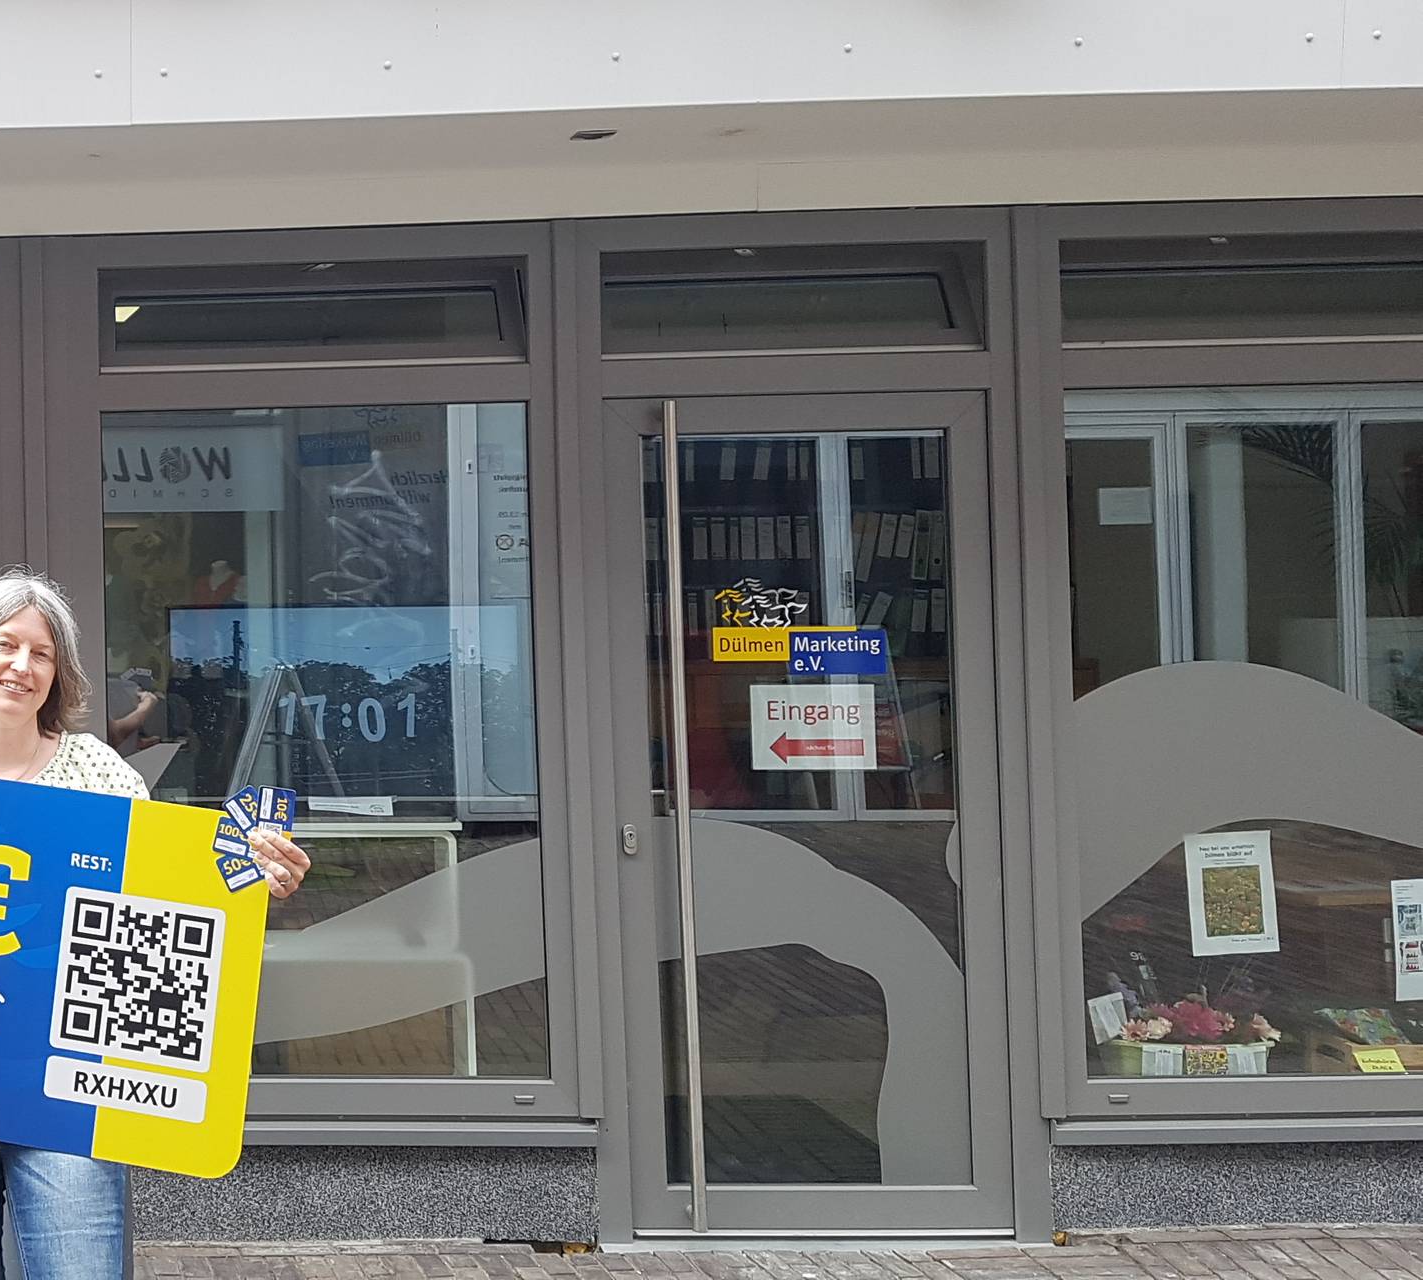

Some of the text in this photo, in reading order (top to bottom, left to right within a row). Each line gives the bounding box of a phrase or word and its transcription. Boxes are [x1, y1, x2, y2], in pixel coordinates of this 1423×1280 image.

[719, 636, 881, 655] Dülmen Marketing
[794, 656, 825, 671] e.V.
[279, 691, 416, 742] 17:01
[767, 700, 860, 726] Eingang
[274, 797, 289, 822] 10€
[70, 853, 112, 873] REST:
[73, 1071, 178, 1108] RXHXXU
